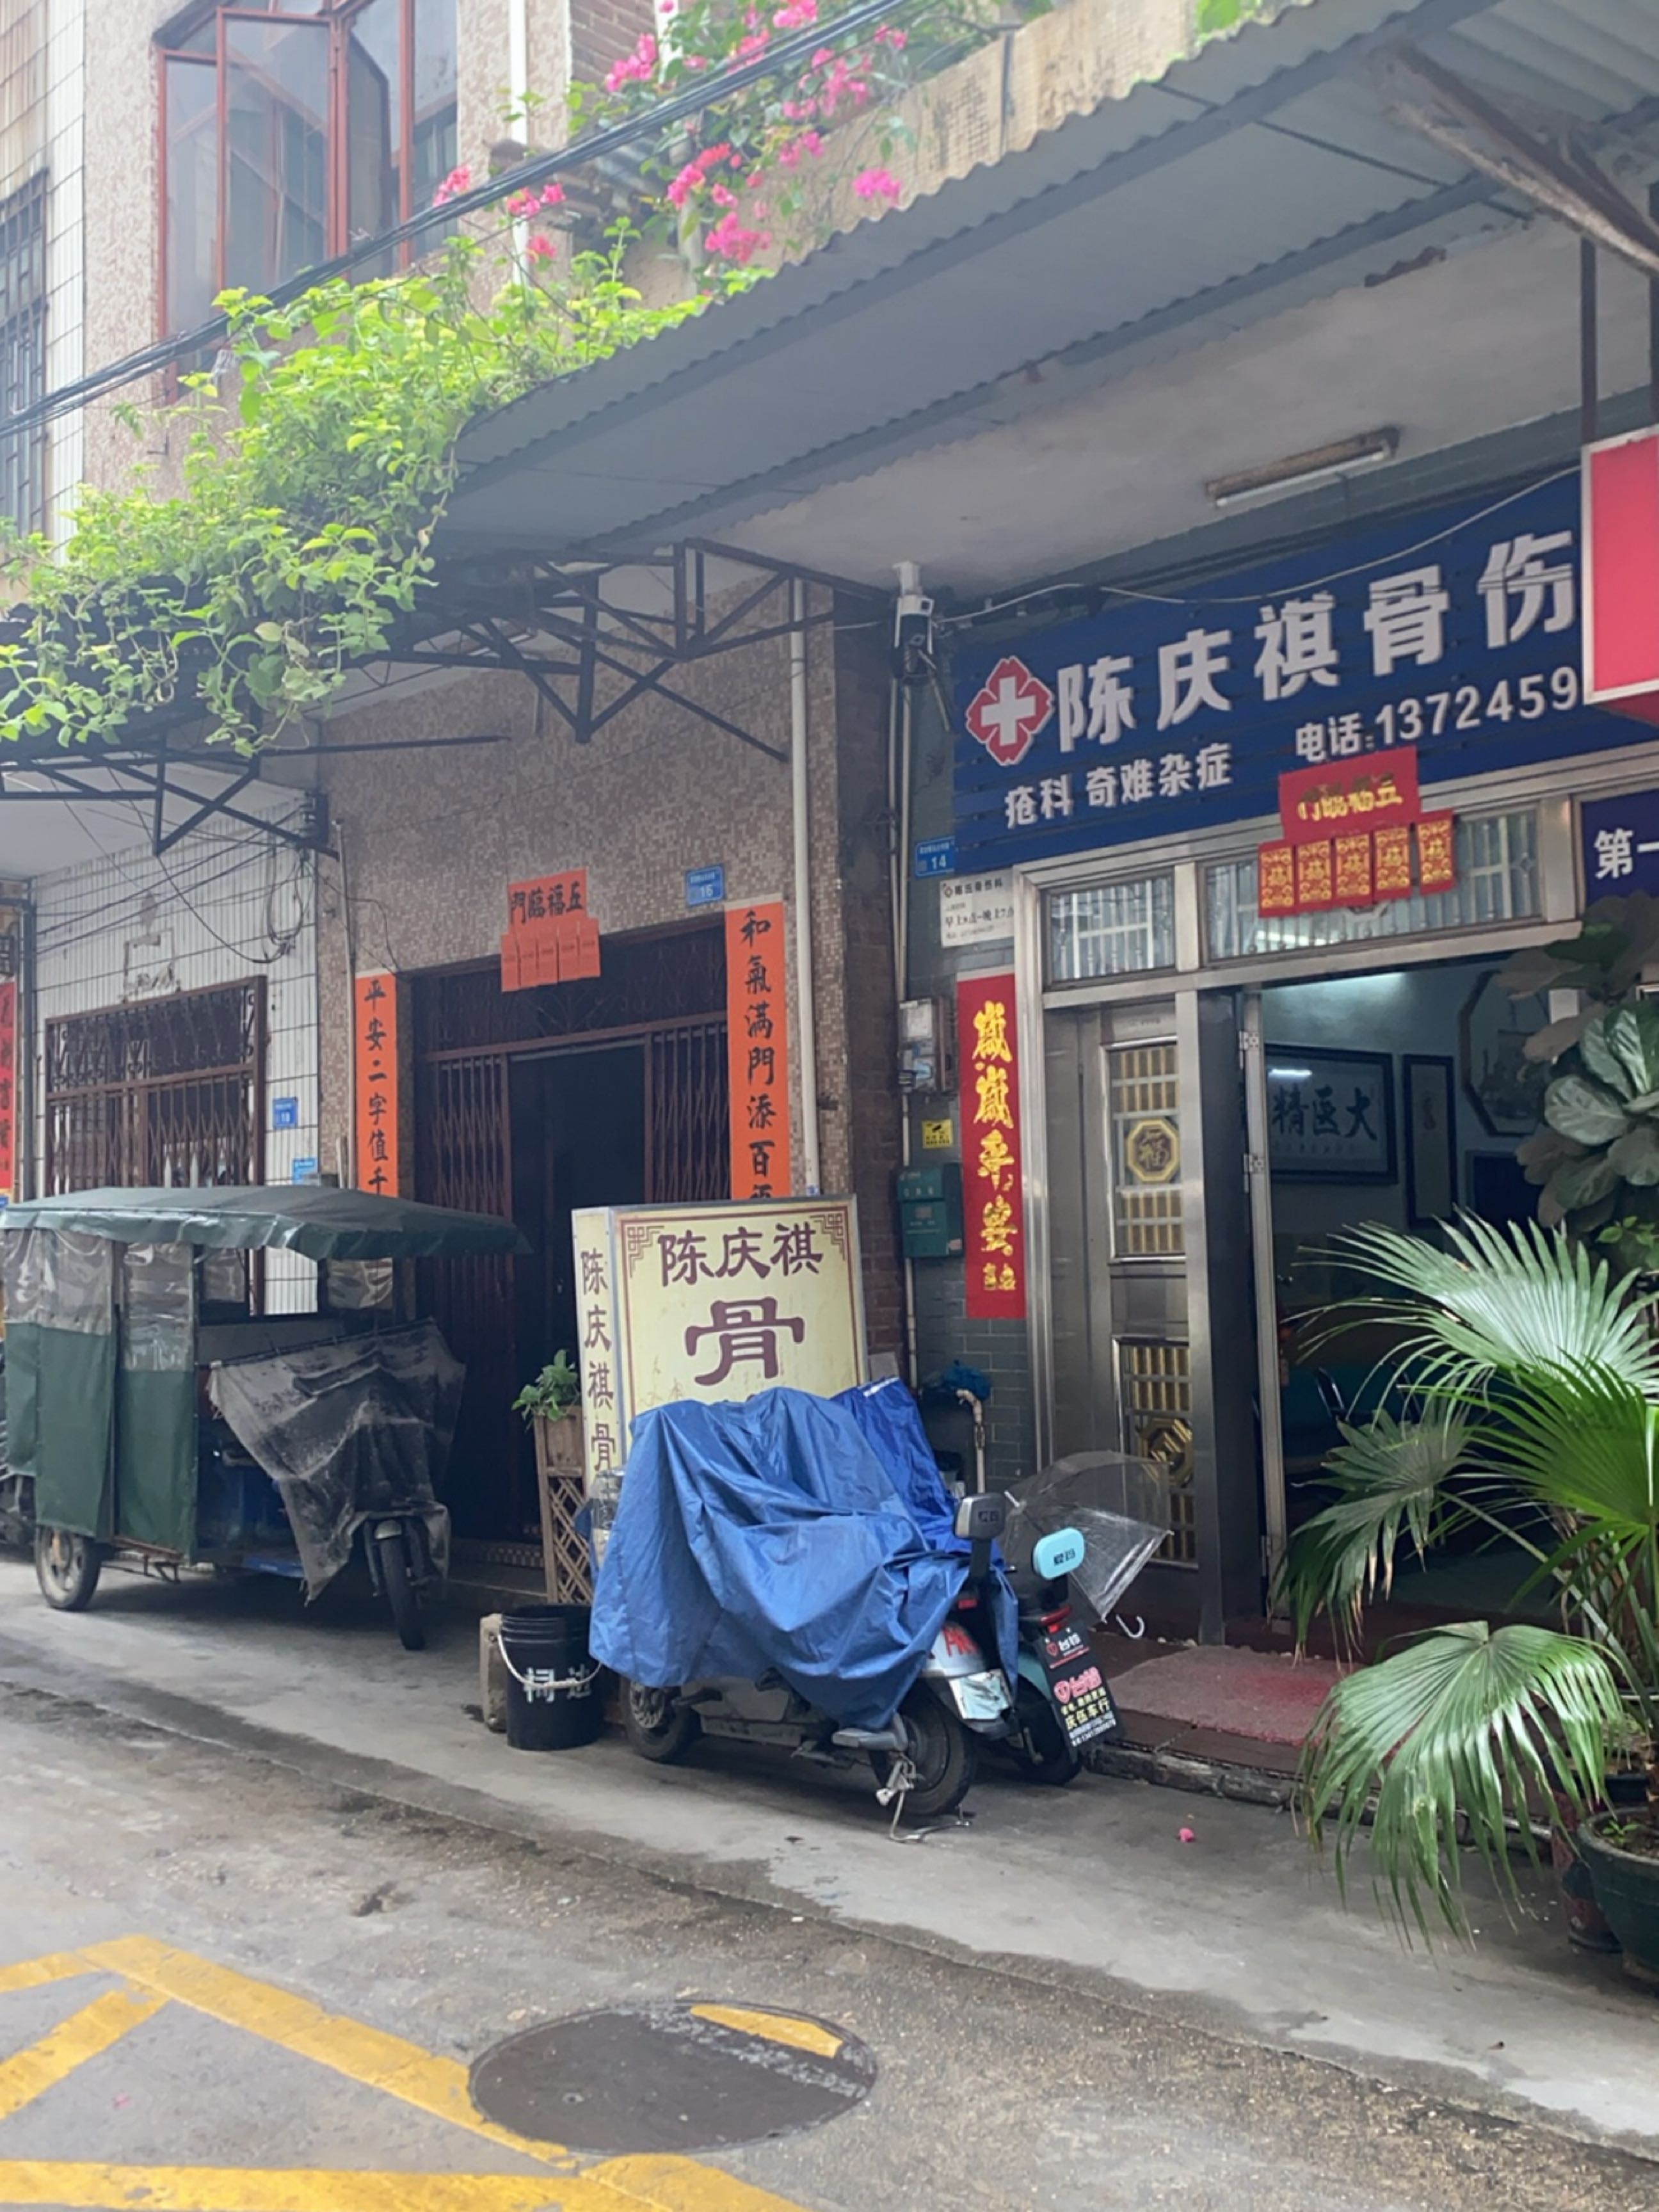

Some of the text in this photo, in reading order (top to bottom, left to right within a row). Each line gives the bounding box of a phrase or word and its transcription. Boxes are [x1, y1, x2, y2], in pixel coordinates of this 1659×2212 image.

[1057, 529, 1580, 753] 陈庆祺骨伤
[1086, 742, 1232, 808] 奇难杂症
[931, 854, 947, 870] 14
[657, 1221, 824, 1287] 陈庆祺
[685, 1297, 805, 1386] 骨
